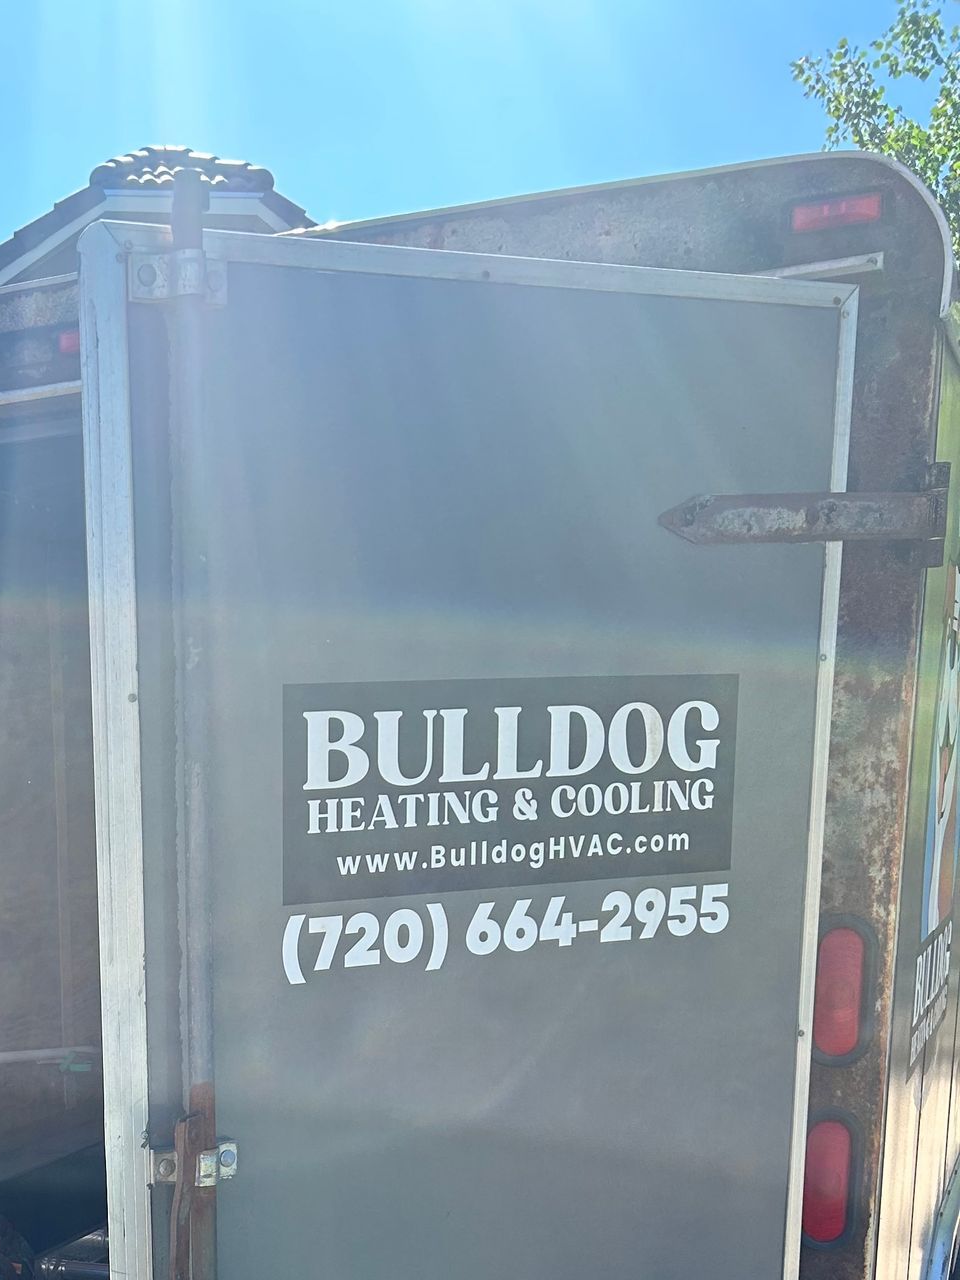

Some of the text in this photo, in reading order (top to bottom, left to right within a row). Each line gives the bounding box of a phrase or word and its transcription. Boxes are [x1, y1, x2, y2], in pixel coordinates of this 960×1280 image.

[302, 700, 721, 790] BULLDOG
[306, 778, 715, 834] HEATING & COOLING
[336, 832, 690, 876] www.BulldogHVAC.com
[282, 883, 729, 985] (720) 664-2955
